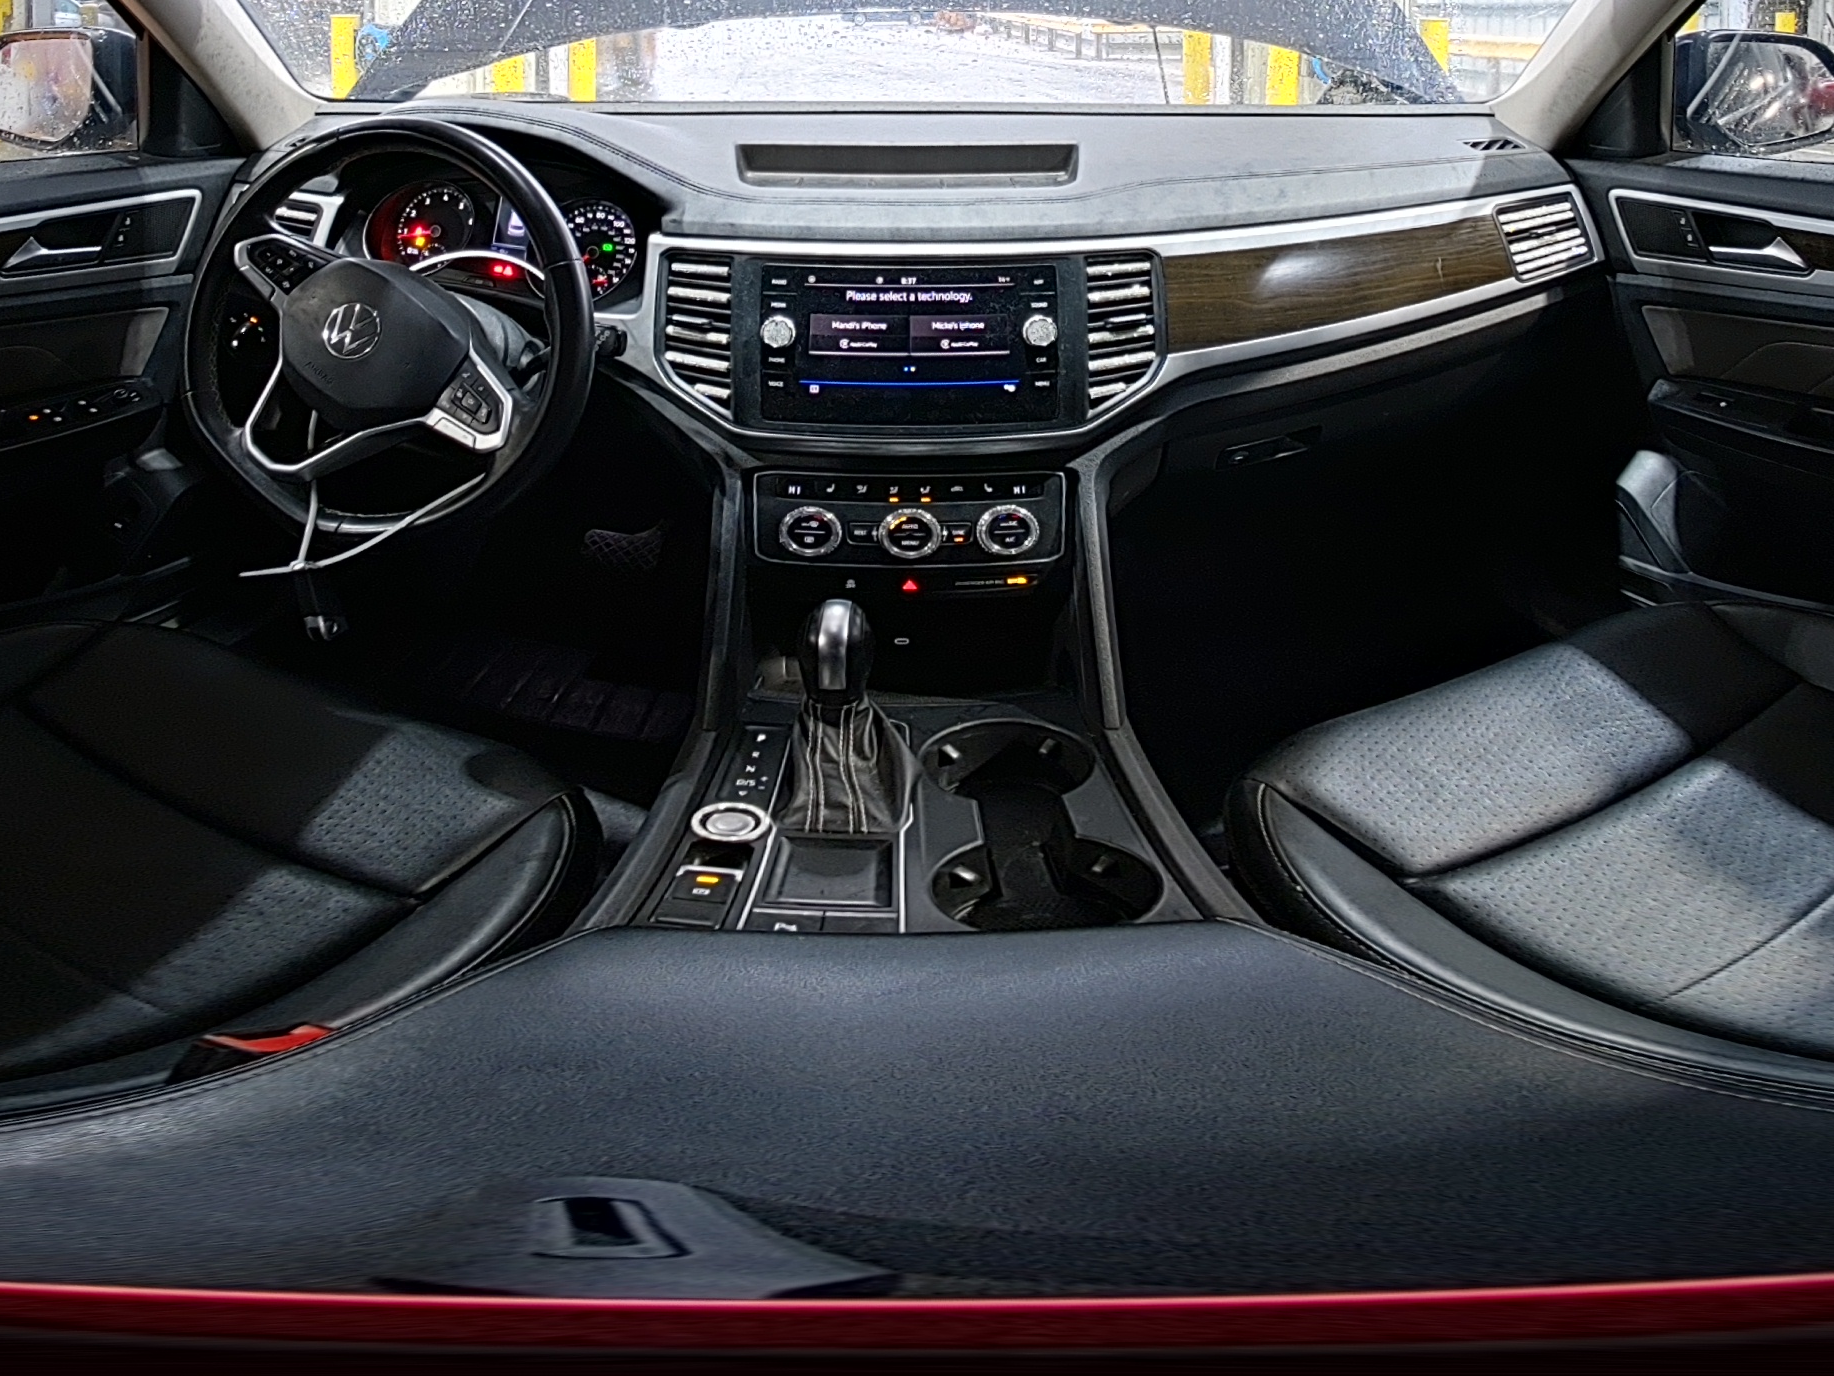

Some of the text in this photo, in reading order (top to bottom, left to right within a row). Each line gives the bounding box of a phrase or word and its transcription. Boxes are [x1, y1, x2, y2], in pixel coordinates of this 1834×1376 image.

[613, 220, 625, 228] 100
[846, 290, 973, 303] Please select a technology.
[745, 764, 756, 773] N
